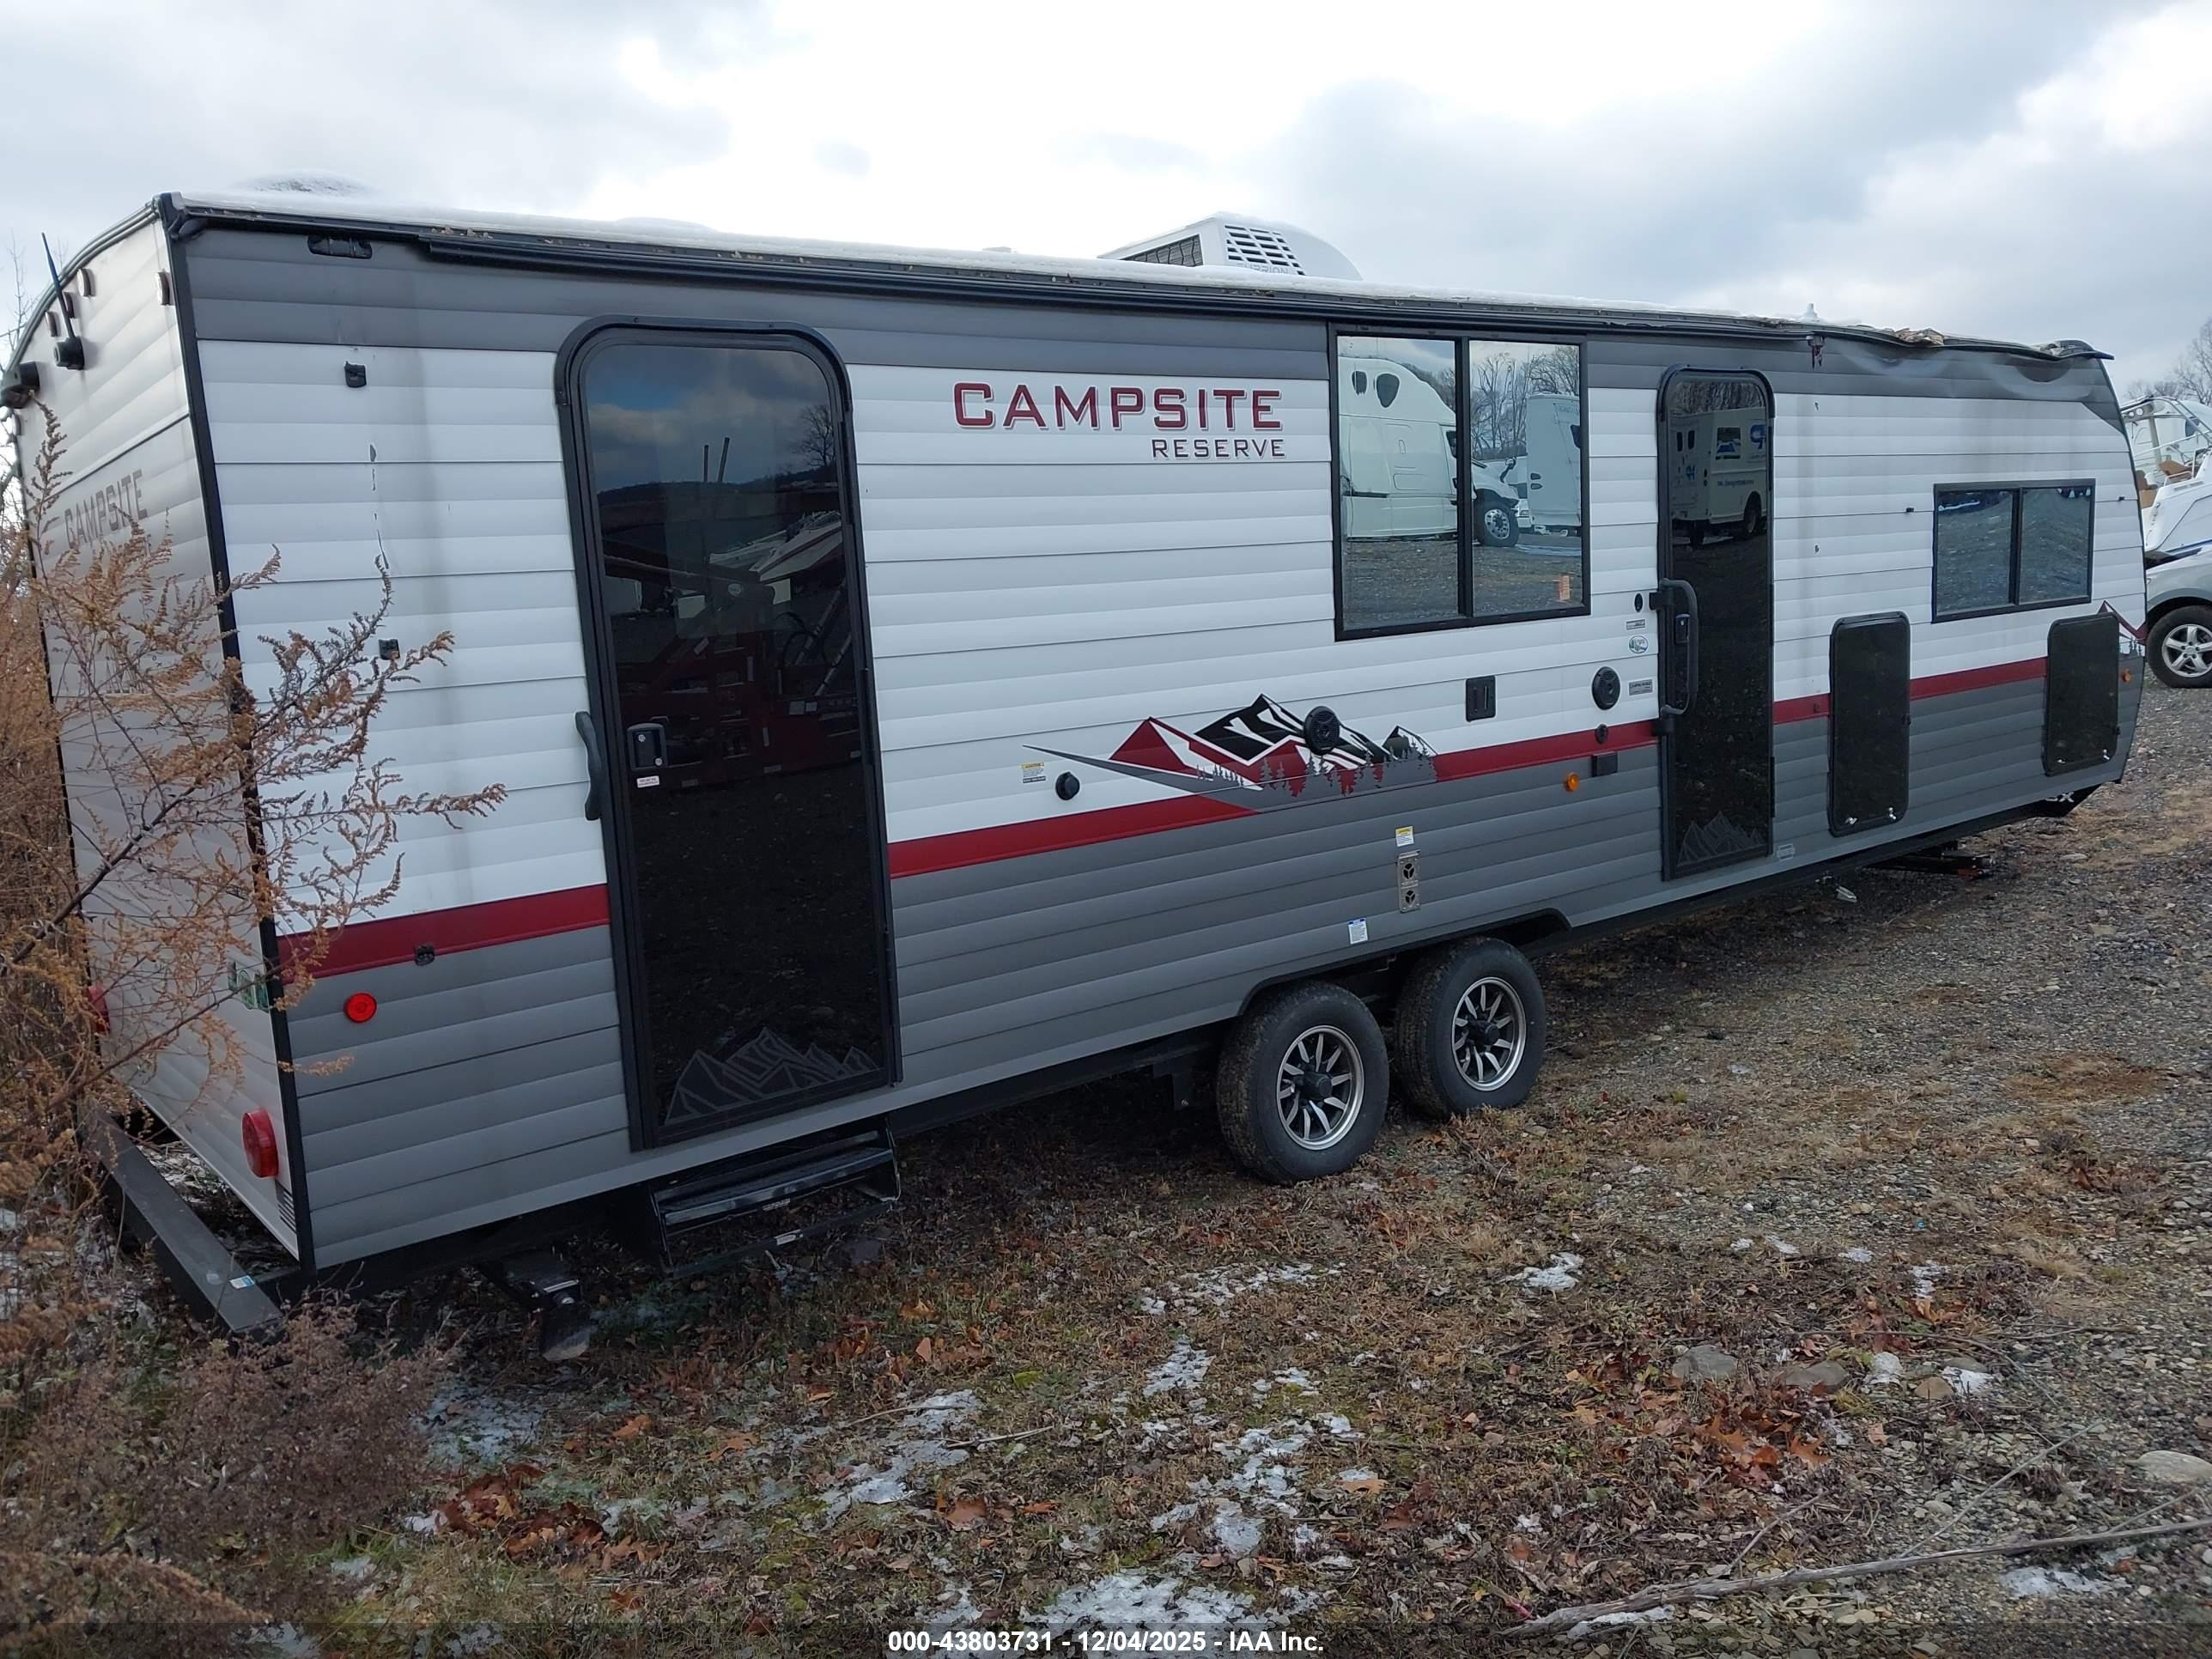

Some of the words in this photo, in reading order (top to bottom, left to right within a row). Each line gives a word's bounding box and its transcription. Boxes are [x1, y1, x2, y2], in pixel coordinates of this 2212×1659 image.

[952, 380, 1282, 429] CAMPSITE
[1151, 438, 1285, 459] RESERVE
[64, 468, 149, 548] CAMPSITE
